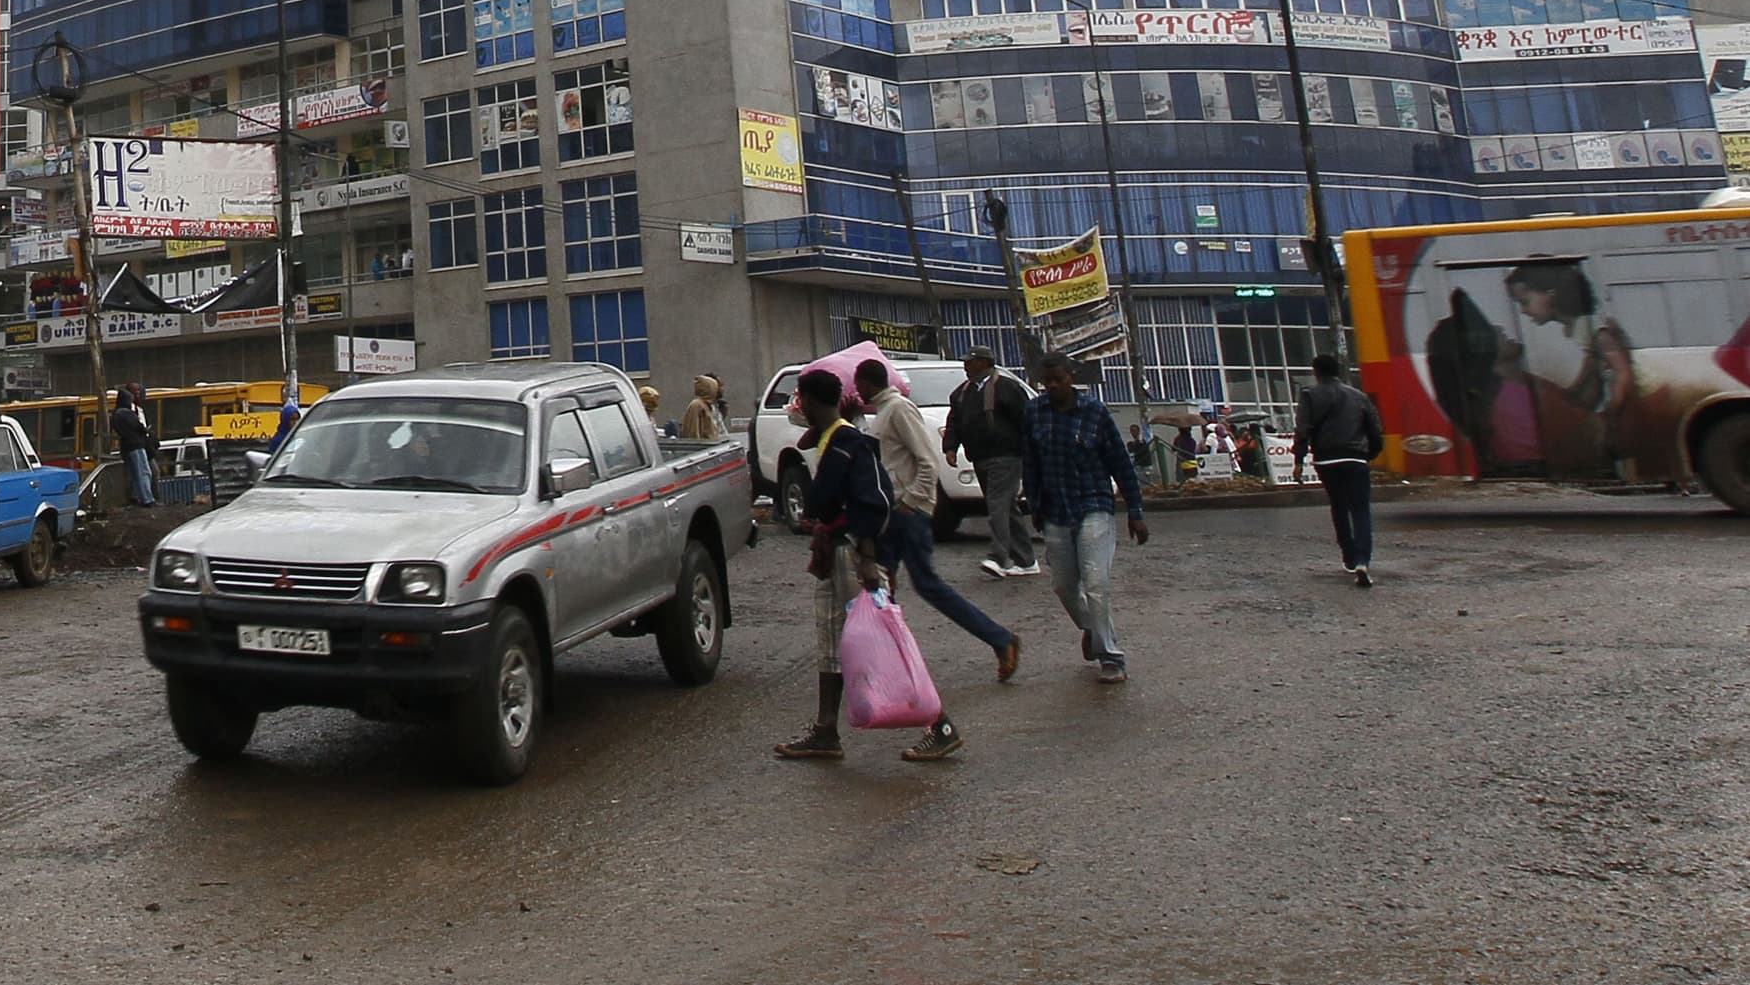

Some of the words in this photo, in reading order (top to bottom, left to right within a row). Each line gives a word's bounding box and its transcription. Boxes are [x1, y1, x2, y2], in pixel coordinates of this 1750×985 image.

[1135, 13, 1232, 35] የጥርስ
[1456, 30, 1497, 50] ቋንቋ
[1509, 28, 1533, 47] እና
[1545, 23, 1643, 46] ኮምፒውተር
[358, 183, 392, 199] Insurance
[139, 195, 190, 213] ት/ቤት
[53, 326, 84, 339] UNIT
[109, 321, 146, 334] BANK
